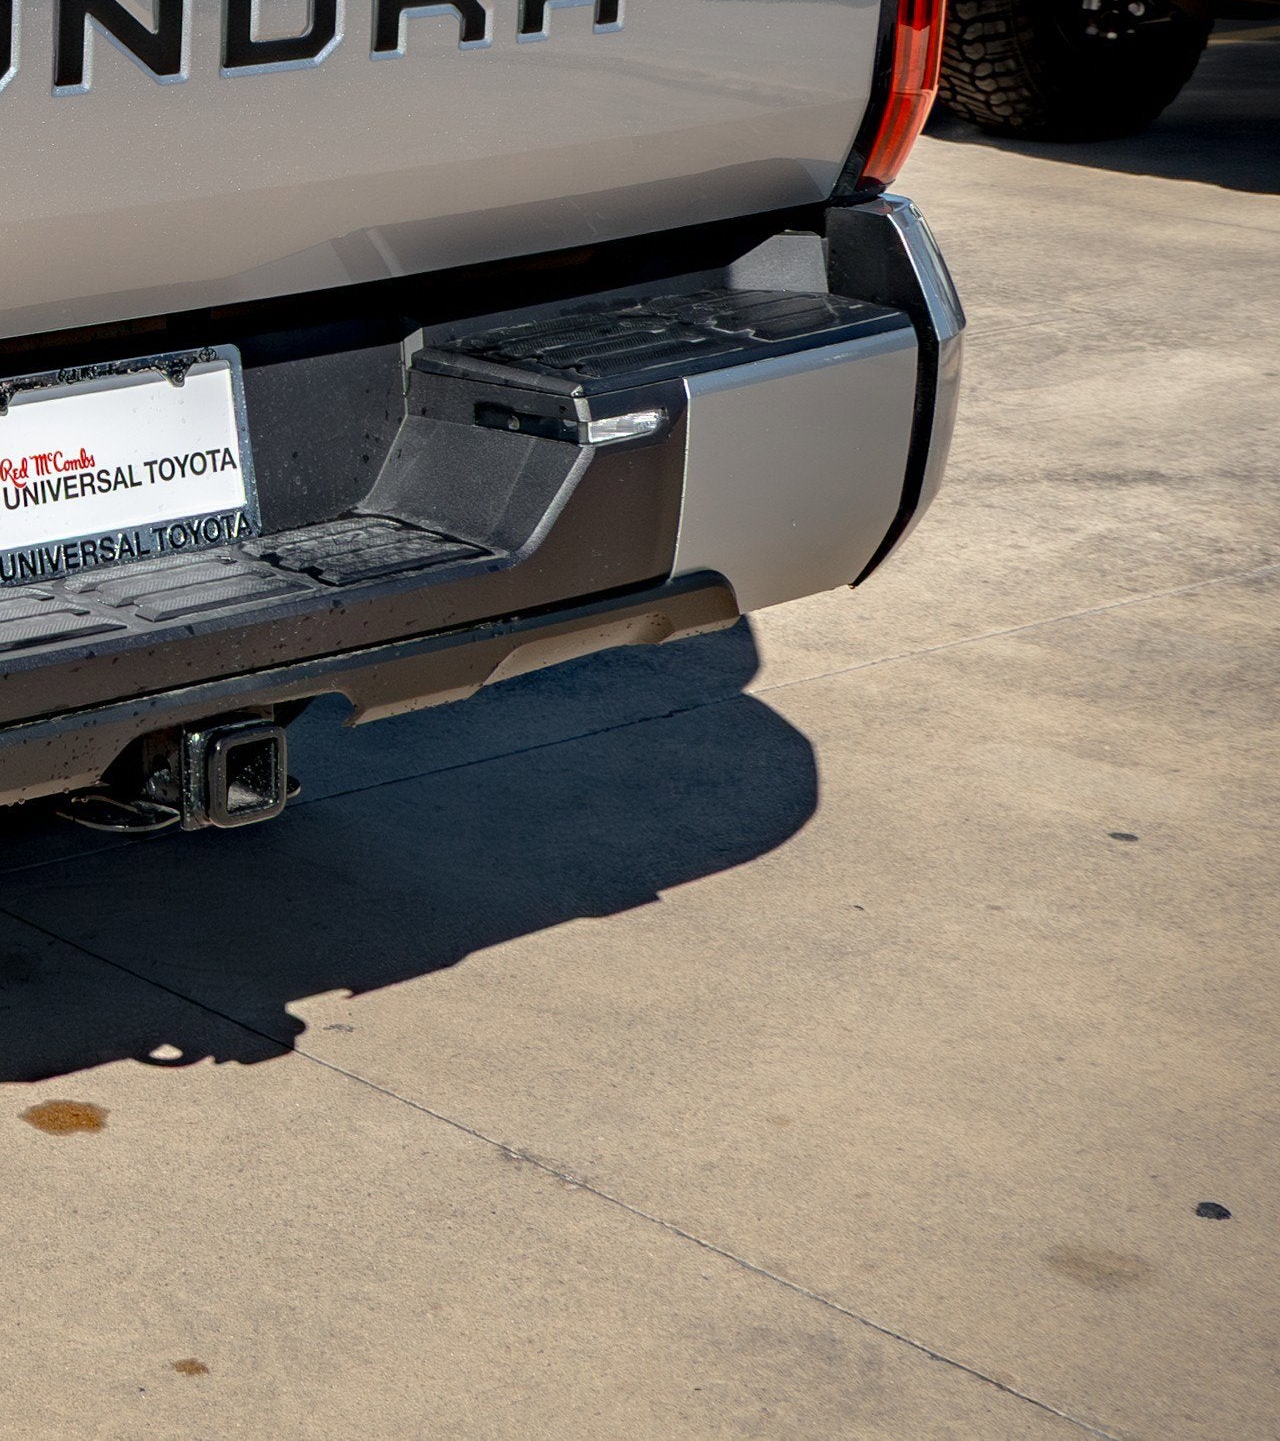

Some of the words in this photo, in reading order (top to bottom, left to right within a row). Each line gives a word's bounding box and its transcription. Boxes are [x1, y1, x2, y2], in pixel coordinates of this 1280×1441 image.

[0, 458, 29, 488] Red
[29, 448, 96, 476] McCombs
[3, 462, 144, 510] UNIVERSAL
[143, 447, 238, 484] TOYOTA
[150, 511, 252, 554] TOYOTA
